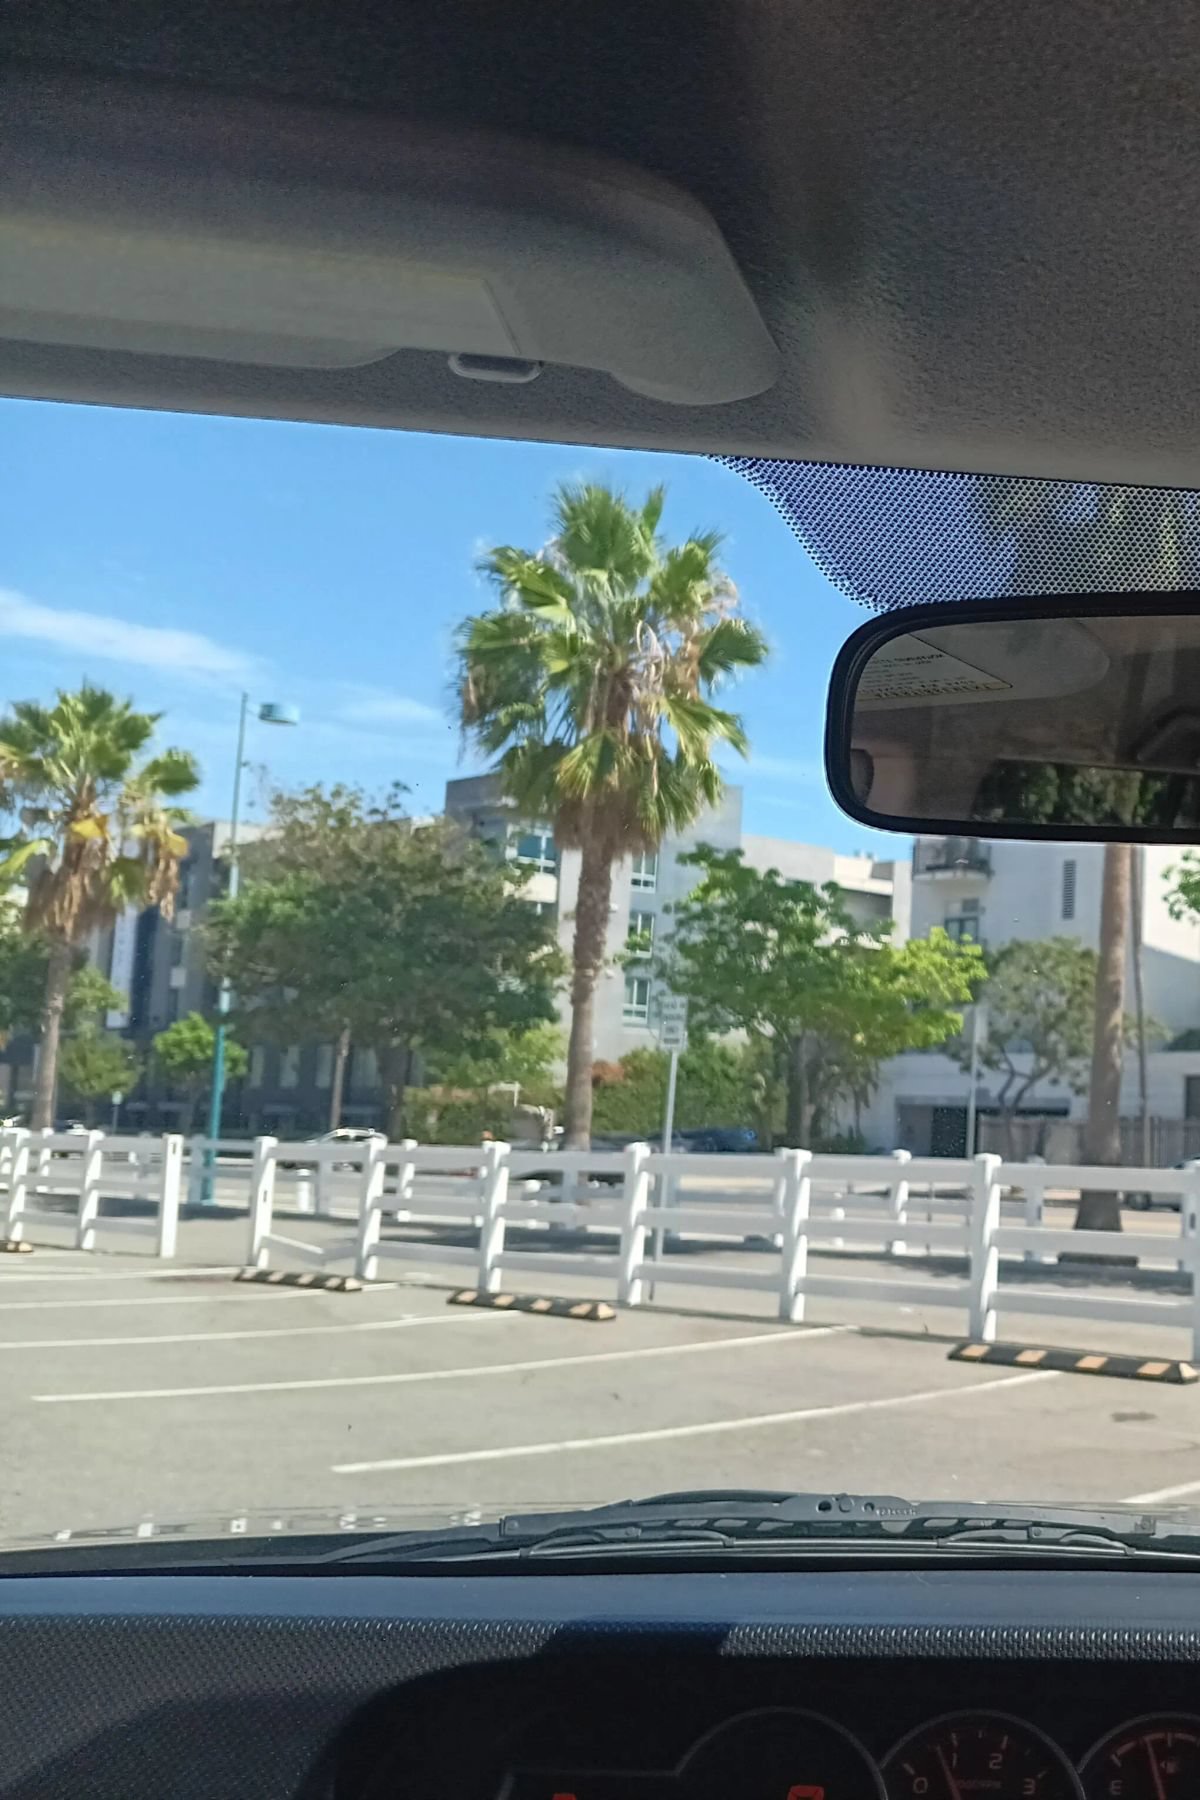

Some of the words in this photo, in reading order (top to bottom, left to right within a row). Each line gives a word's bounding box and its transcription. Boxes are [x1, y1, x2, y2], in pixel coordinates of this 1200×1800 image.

[952, 1752, 958, 1768] 1
[988, 1753, 1003, 1769] 2
[912, 1777, 928, 1794] 0
[1023, 1778, 1036, 1794] 3
[1109, 1780, 1123, 1796] E
